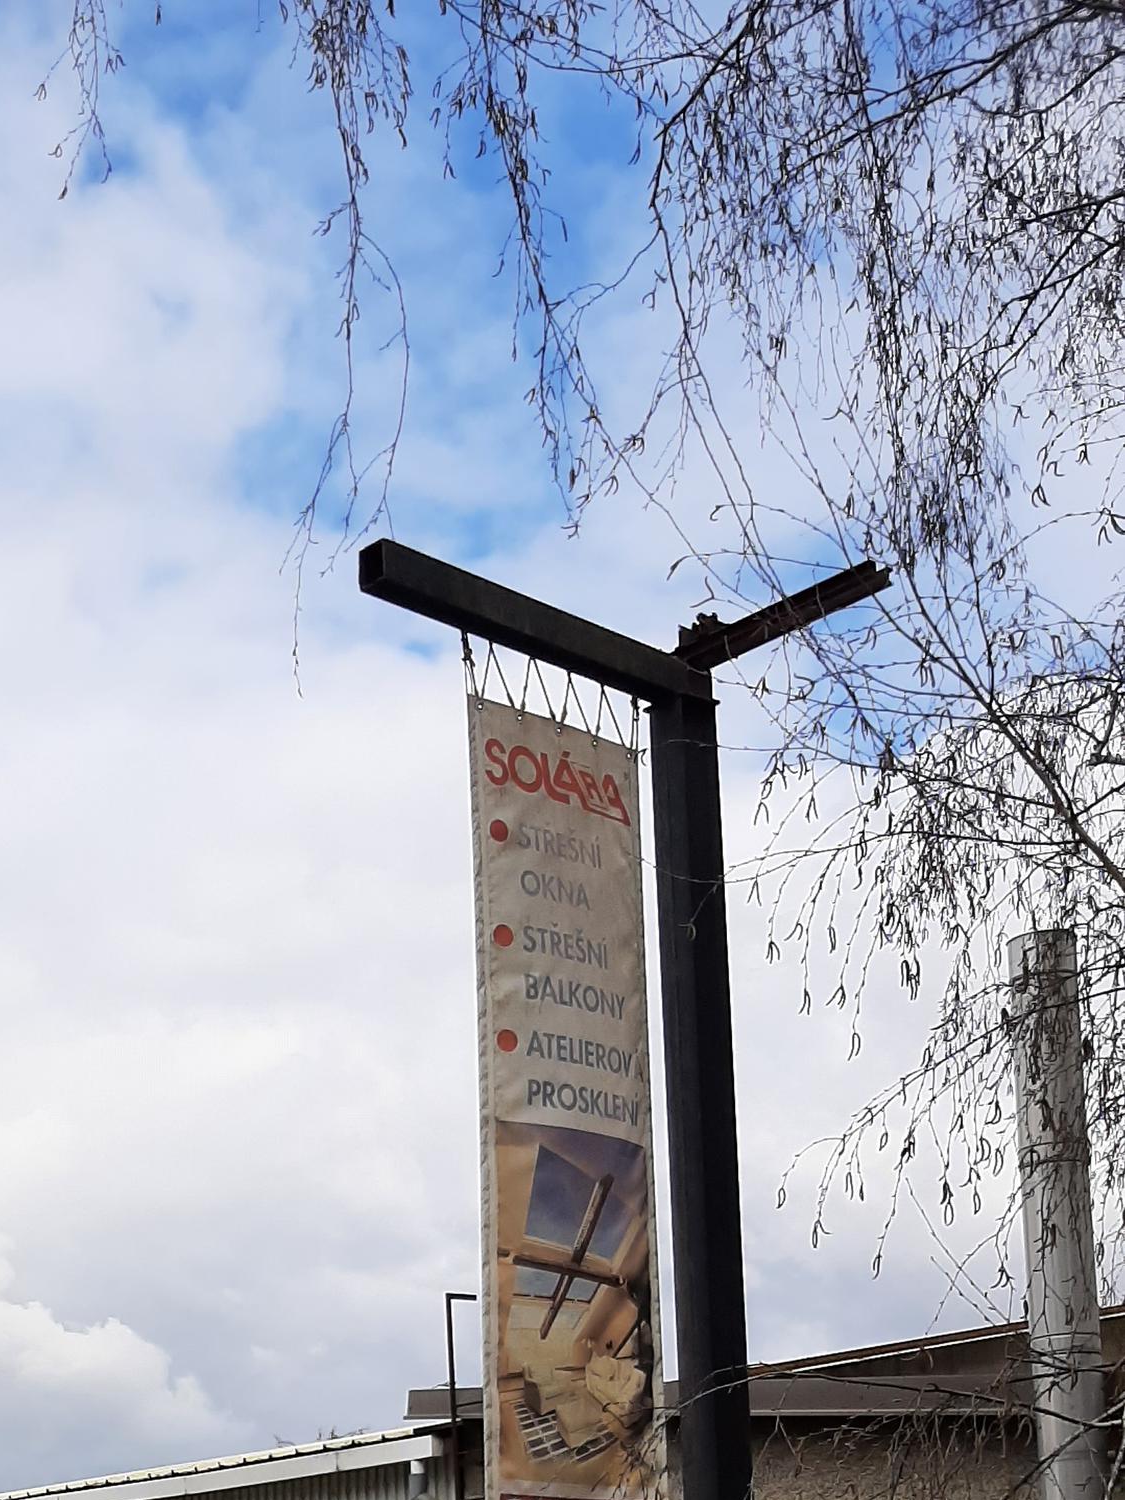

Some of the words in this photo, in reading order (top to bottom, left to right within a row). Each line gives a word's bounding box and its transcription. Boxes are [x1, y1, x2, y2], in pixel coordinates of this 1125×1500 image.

[484, 738, 631, 826] SOLÁRA
[516, 821, 602, 869] STŘEŠNÍ
[520, 869, 591, 912] OKNA
[522, 922, 609, 969] STŘEŠNÍ
[524, 973, 625, 1020] BALKONY
[526, 1078, 640, 1126] PROSKLENÍ
